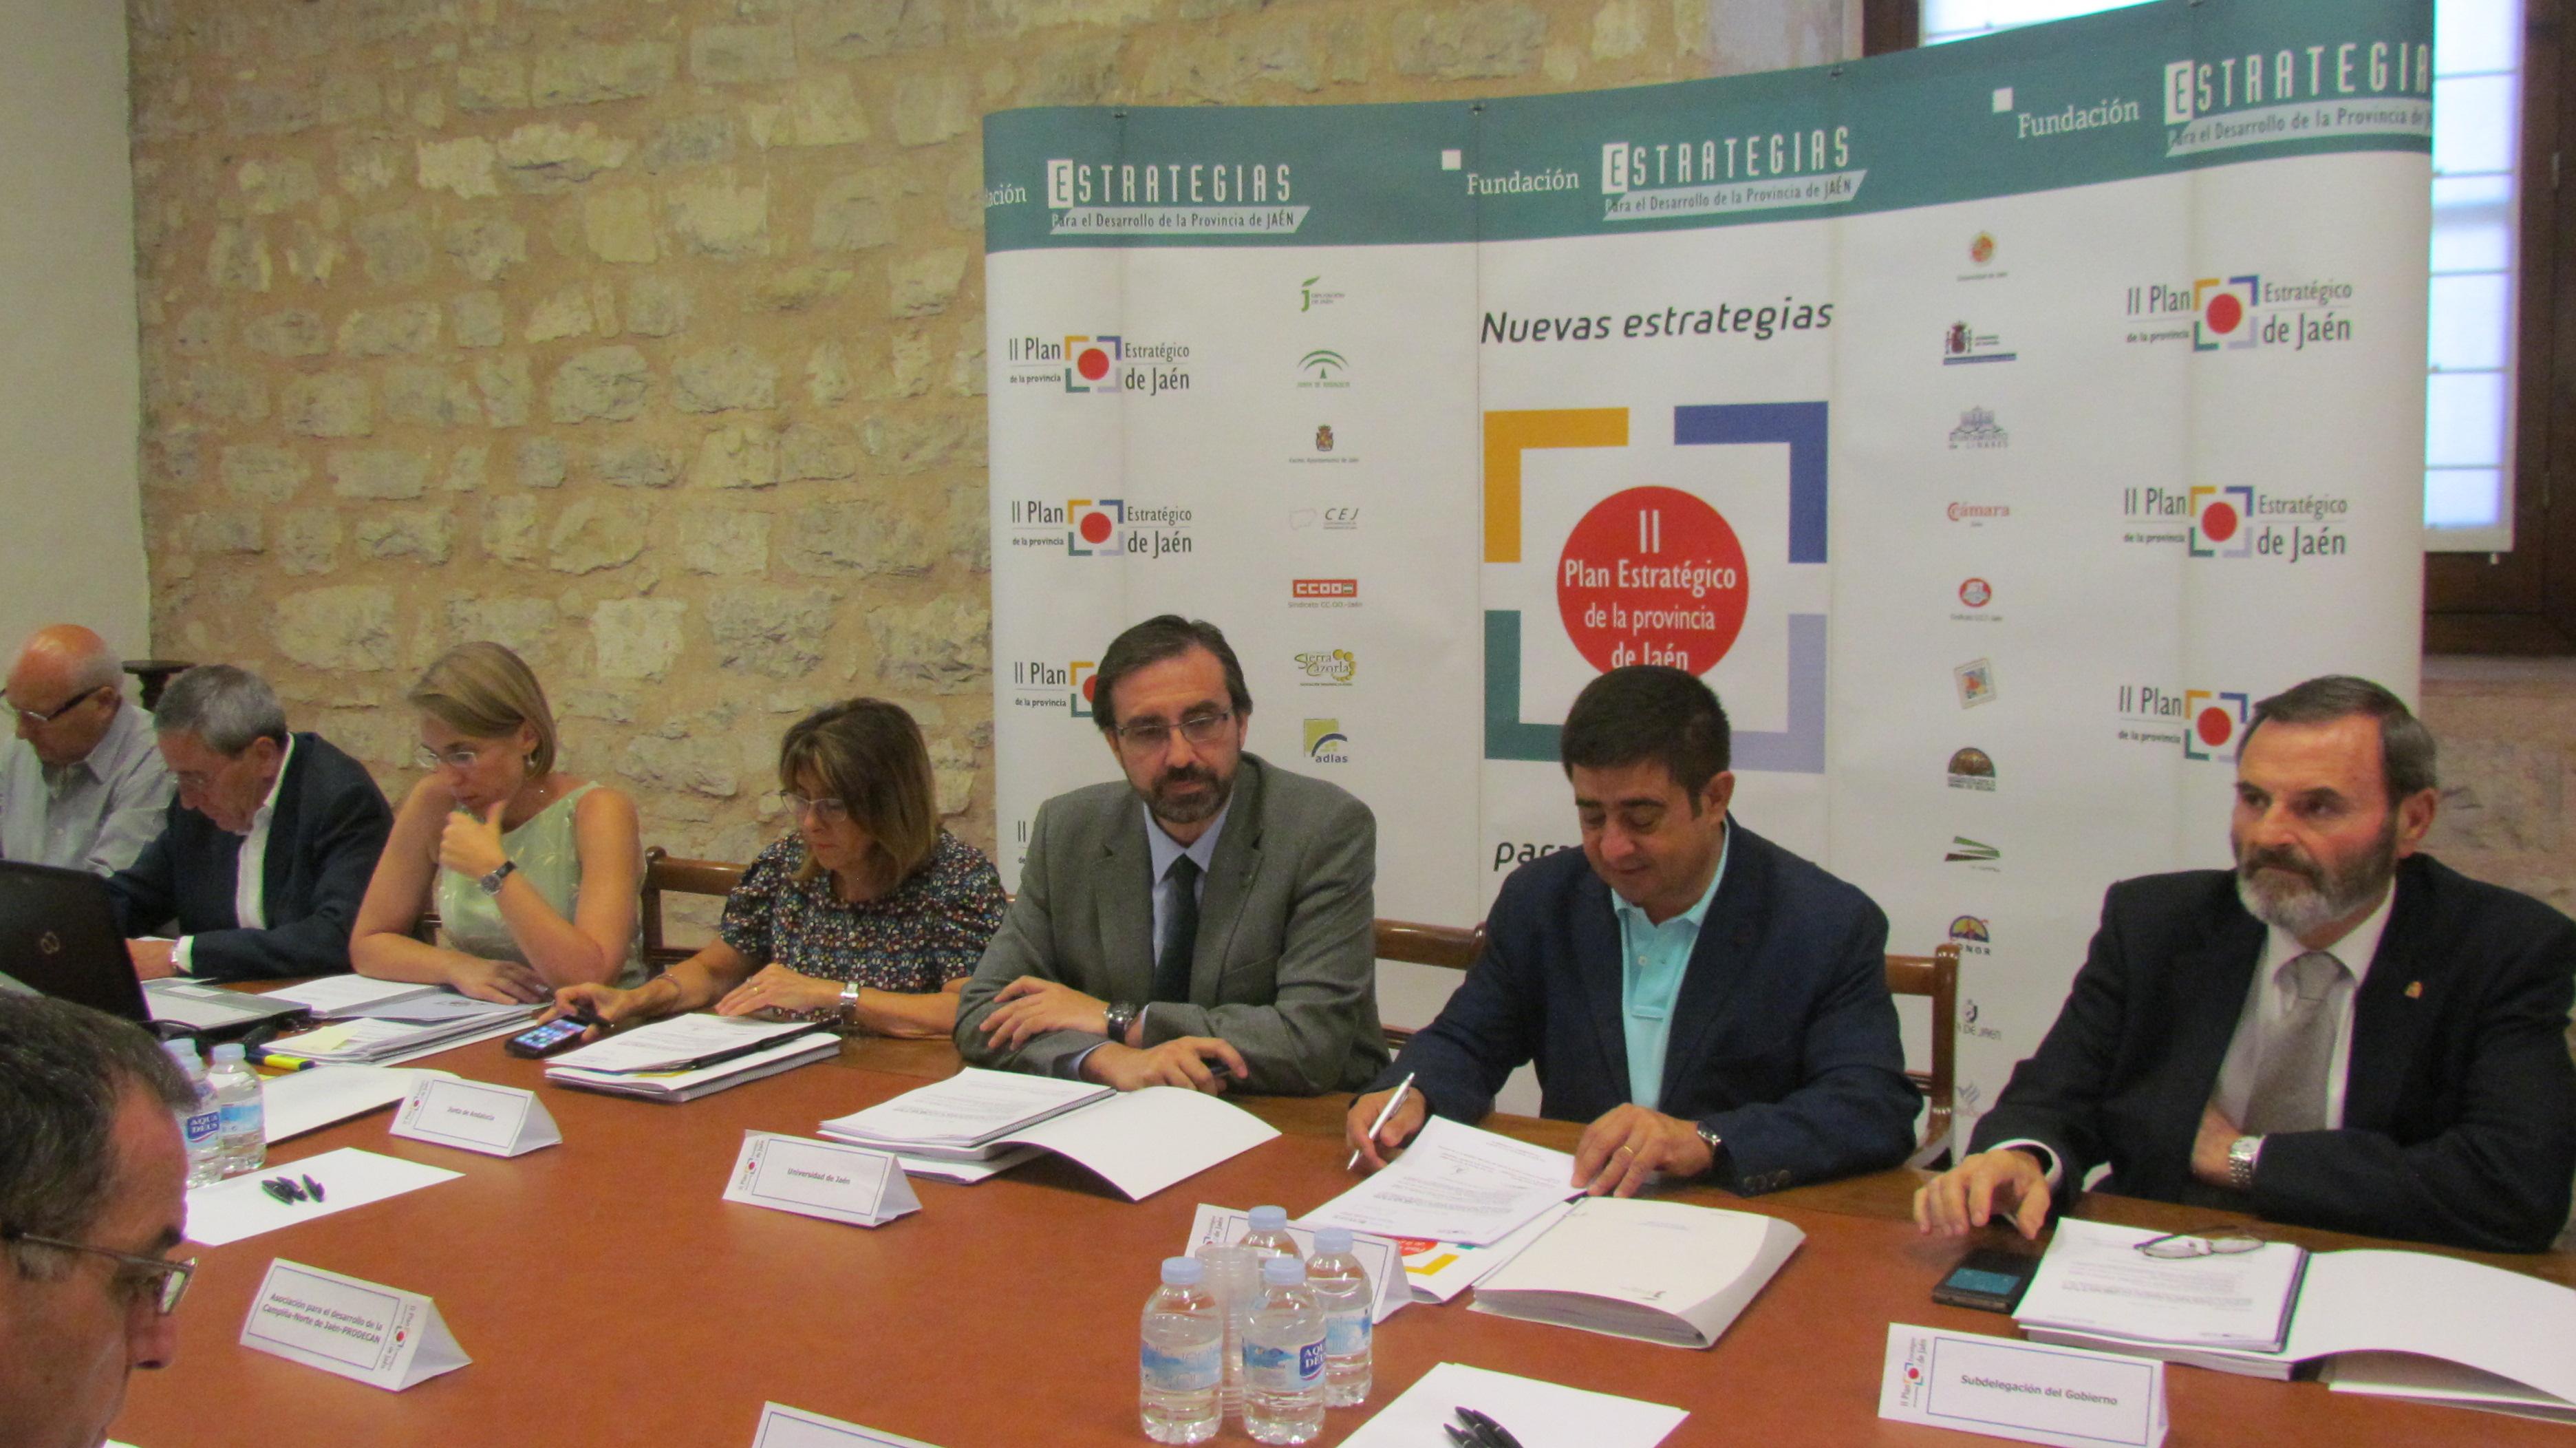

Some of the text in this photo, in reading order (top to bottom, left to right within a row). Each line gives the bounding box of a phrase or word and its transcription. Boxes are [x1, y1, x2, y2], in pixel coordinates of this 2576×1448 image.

[2017, 97, 2140, 138] Fundación
[2215, 113, 2285, 140] Desarrollo
[2292, 112, 2308, 129] de
[2316, 109, 2329, 127] la
[2337, 107, 2406, 125] Provincia
[1611, 126, 1849, 188] ESTRATEGIAS
[1056, 164, 1291, 203] ESTRATEGIAS
[1467, 168, 1580, 195] Fundación
[1635, 197, 1645, 211] el
[1651, 192, 1709, 210] Desarrollo
[1714, 192, 1727, 205] de
[1732, 191, 1741, 204] la
[1747, 187, 1801, 202] Provincia
[1806, 183, 1820, 196] de
[1825, 175, 1852, 200] JAÉN
[1051, 209, 1294, 230] Para el Desarrollo de la Provincia de JAÉN
[2127, 284, 2191, 315] II Plan
[2264, 279, 2353, 305] Estratégico
[1481, 296, 1836, 344] Nuevas estrategias
[2264, 312, 2351, 351] de Jaén
[1009, 337, 1061, 361] II Plan
[1125, 342, 1190, 362] Estratégico
[1027, 374, 1062, 385] provincia
[1126, 367, 1190, 396] de Jaén
[1012, 500, 1064, 523] II Plan
[2125, 487, 2187, 515] II Plan
[2258, 493, 2348, 520] Estratégico
[1128, 506, 1192, 526] Estratégico
[1013, 535, 1064, 548] de la provincia
[1128, 531, 1192, 560] de Jaén
[1640, 510, 1660, 553] II
[2257, 526, 2346, 563] de Jaén
[1565, 560, 1737, 599] Plan Estratégico
[1585, 602, 1715, 637] de la provincia
[1611, 641, 1636, 668] de
[1015, 661, 1066, 685] II Plan
[1015, 697, 1066, 708] de la provincia
[2119, 686, 2182, 717] II Plan
[1494, 842, 1569, 872] par
[787, 1168, 850, 1185] Universidad de Jaén
[270, 1293, 305, 1308] Asociación
[305, 1304, 323, 1315] para
[331, 1310, 365, 1326] desarrollo
[365, 1319, 376, 1329] de
[314, 1319, 324, 1328] de
[1961, 1374, 2118, 1406] Subdelegación del Gobierno
